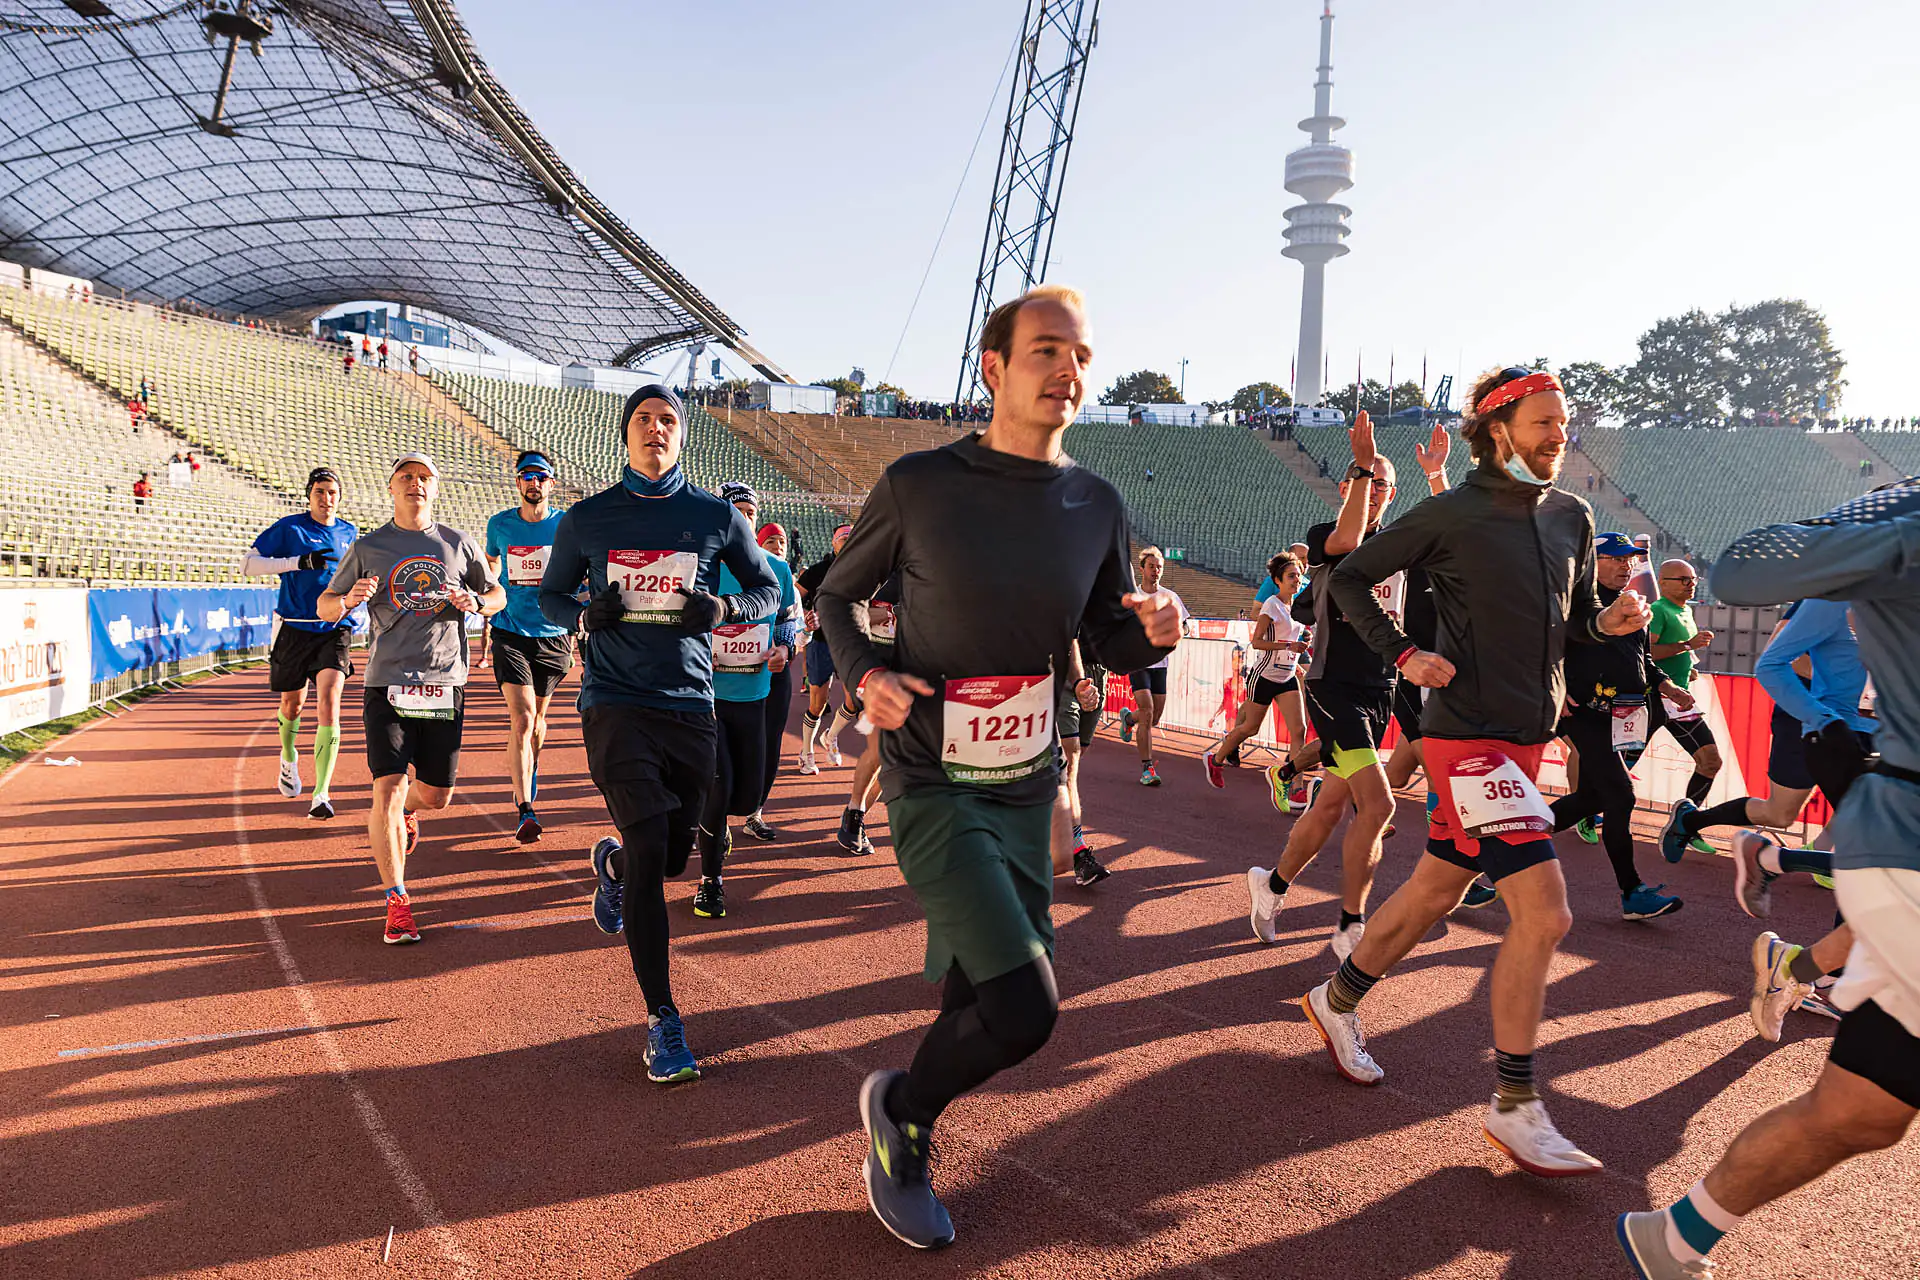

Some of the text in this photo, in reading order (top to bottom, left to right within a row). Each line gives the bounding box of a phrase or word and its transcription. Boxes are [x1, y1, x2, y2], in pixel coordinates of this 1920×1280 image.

[414, 561, 441, 574] PÖLTEN
[521, 559, 542, 570] 859
[622, 573, 684, 594] 12265
[640, 595, 663, 604] Patrick
[722, 641, 761, 654] 12021
[401, 685, 442, 697] 12195
[967, 709, 1049, 742] 12211
[1623, 721, 1634, 732] 52
[946, 743, 957, 754] A
[998, 745, 1023, 757] Felix
[1483, 779, 1526, 800] 365
[1460, 805, 1469, 815] A
[1480, 821, 1527, 834] MARATHON
